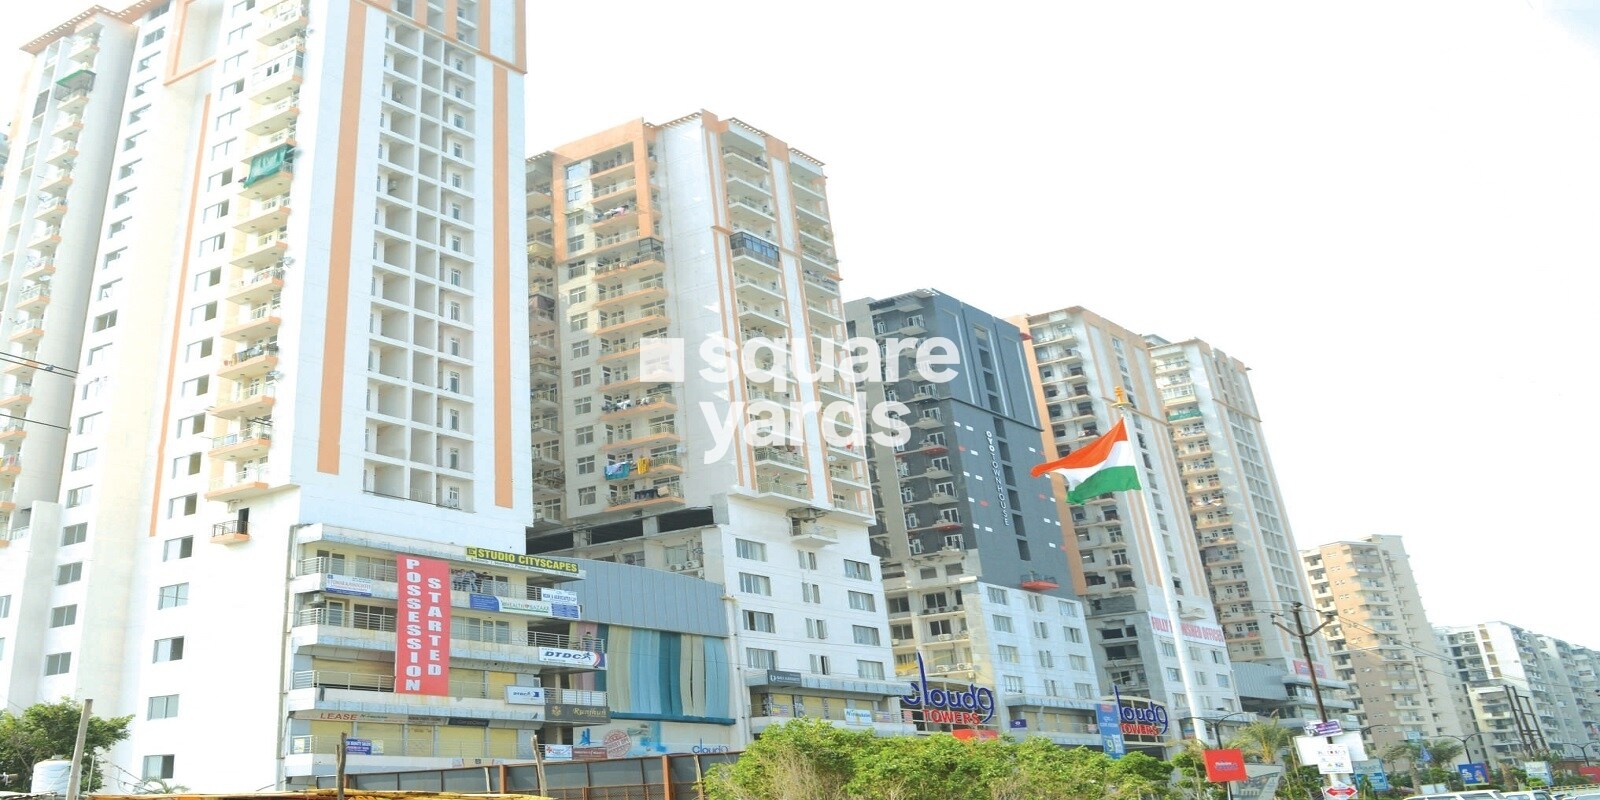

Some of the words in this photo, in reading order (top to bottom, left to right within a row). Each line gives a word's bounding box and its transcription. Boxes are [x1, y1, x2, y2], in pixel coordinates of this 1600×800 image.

[478, 549, 515, 563] STUDIO
[518, 555, 577, 572] CITYSCAPES
[405, 558, 422, 691] POSSESSION
[427, 577, 443, 676] STARTED
[1151, 616, 1169, 632] FULLY
[544, 651, 582, 660] DTDC
[320, 712, 358, 721] LEASE
[922, 709, 981, 726] TOWERS
